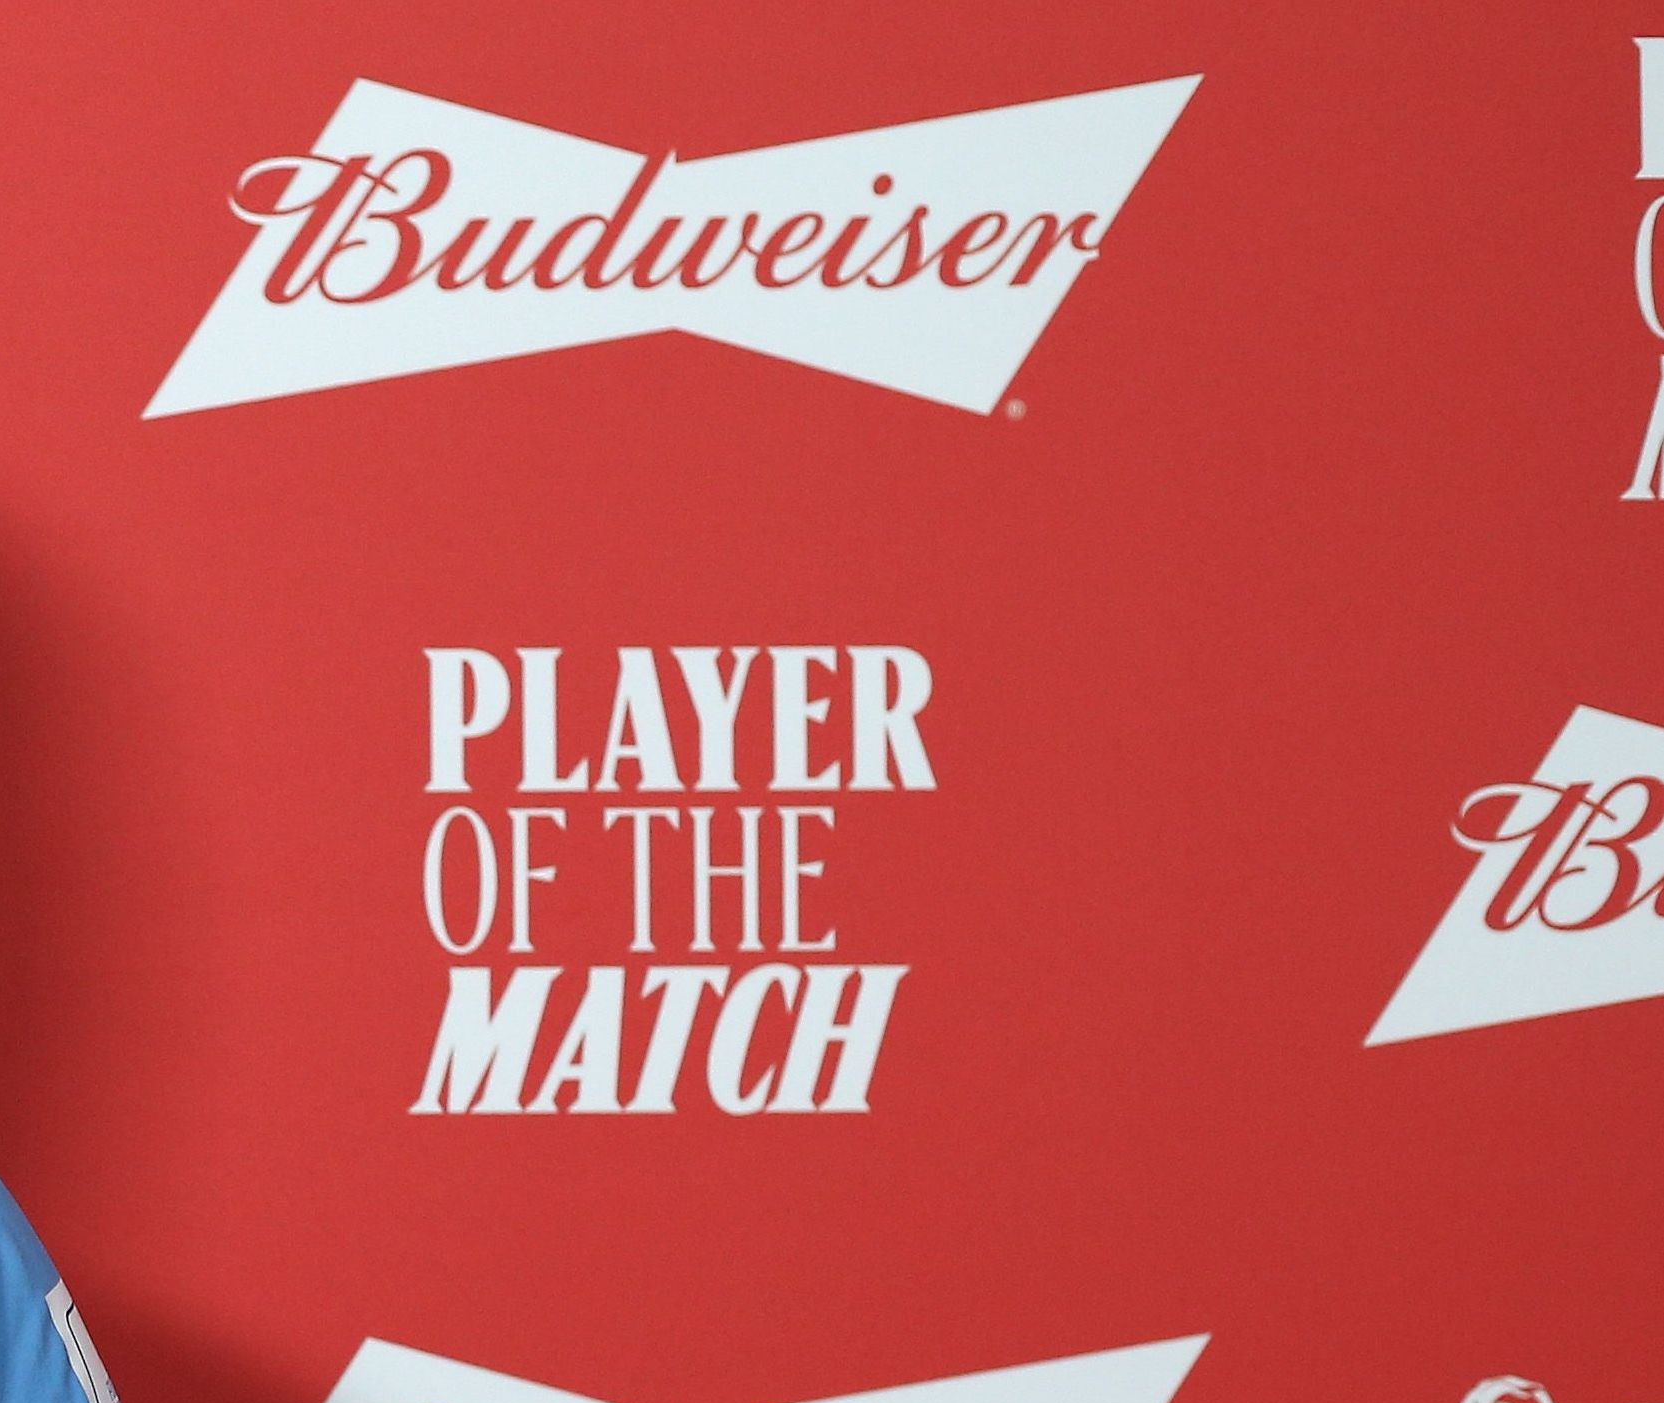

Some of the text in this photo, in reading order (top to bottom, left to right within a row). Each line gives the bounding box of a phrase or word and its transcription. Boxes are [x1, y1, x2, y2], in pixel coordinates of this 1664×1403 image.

[229, 147, 1101, 305] Budweiser
[424, 646, 937, 793] PLAYER
[423, 806, 836, 955] OF THE
[409, 963, 909, 1116] MATCH
